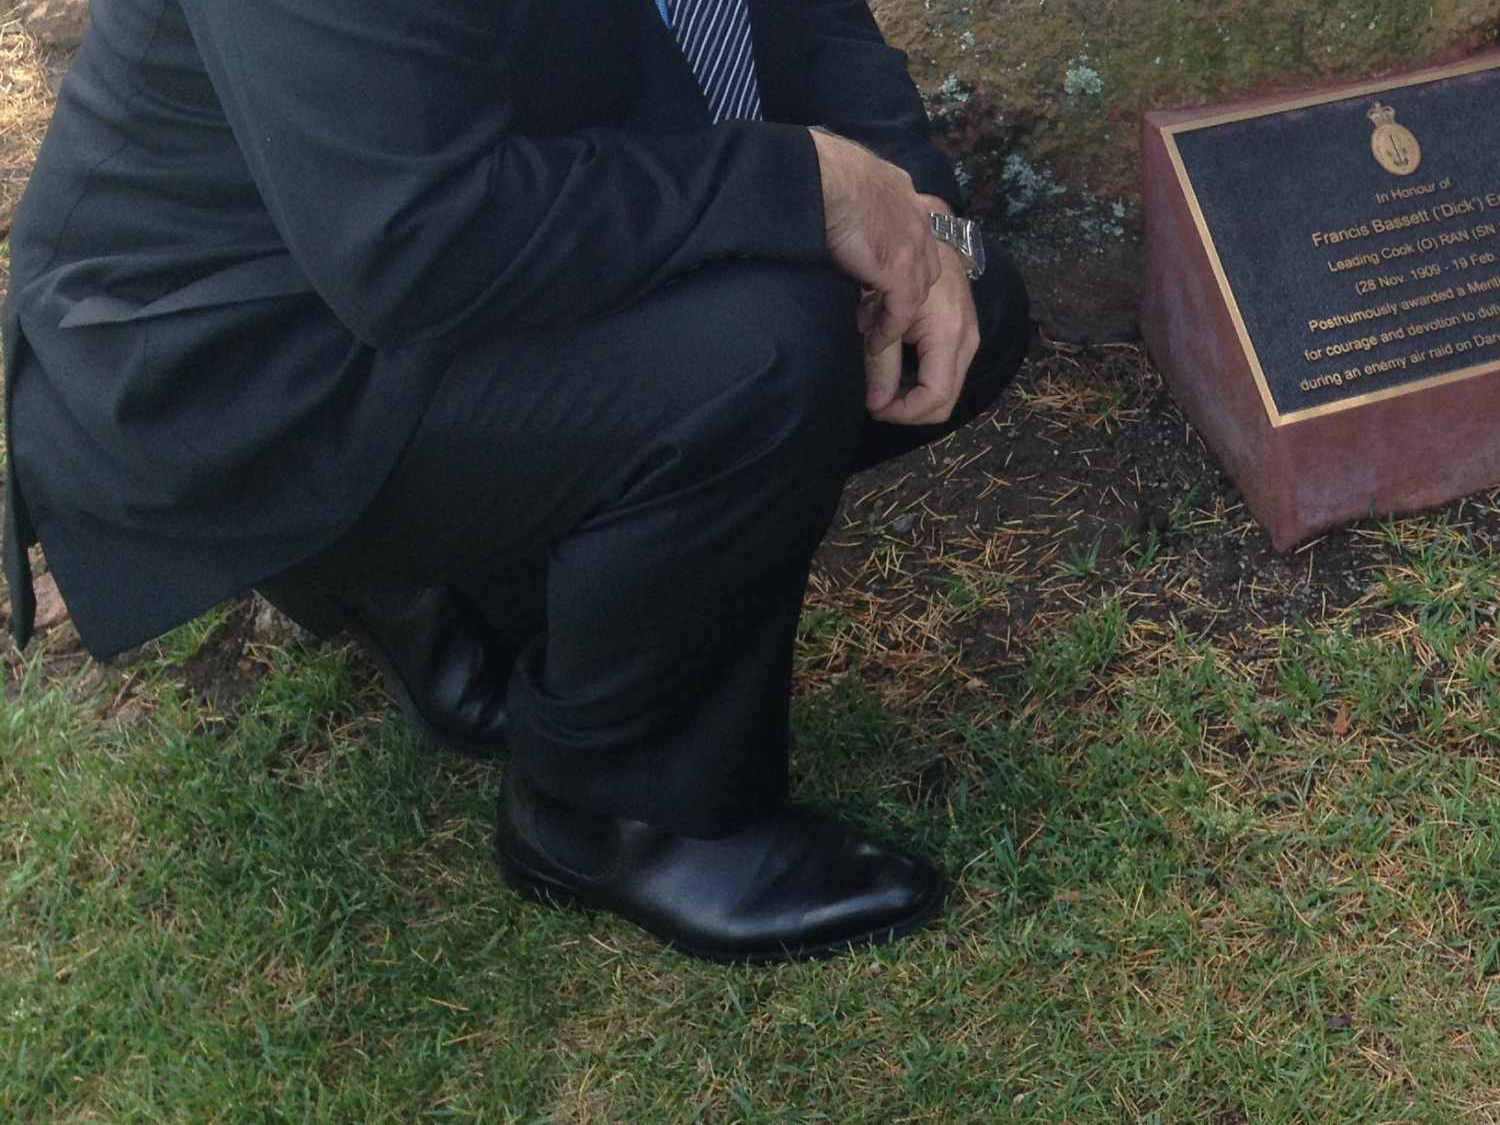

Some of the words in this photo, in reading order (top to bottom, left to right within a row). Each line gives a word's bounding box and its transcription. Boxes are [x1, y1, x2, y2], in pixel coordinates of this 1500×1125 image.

[1376, 192, 1390, 203] In
[1391, 182, 1436, 200] Honour
[1439, 177, 1452, 189] of
[1312, 224, 1370, 247] Francis
[1371, 210, 1430, 233] Bassett
[1328, 251, 1380, 272] Leading
[1381, 243, 1415, 259] Cook
[1417, 237, 1439, 253] (O)
[1440, 229, 1470, 245] RAN
[1471, 222, 1496, 240] (SN
[1355, 279, 1377, 296] (28
[1410, 263, 1441, 280] 1909
[1452, 257, 1469, 270] 19
[1308, 302, 1399, 331] Posthumously
[1400, 288, 1455, 311] awarded
[1455, 286, 1466, 297] a
[1304, 349, 1323, 362] for
[1326, 335, 1379, 357] courage
[1380, 327, 1405, 343] and
[1407, 313, 1461, 336] devotion
[1462, 310, 1476, 323] to
[1300, 372, 1344, 392] during
[1344, 366, 1362, 381] an
[1364, 357, 1408, 375] enemy
[1409, 349, 1426, 364] air
[1428, 342, 1454, 360] raid
[1455, 338, 1473, 352] on
